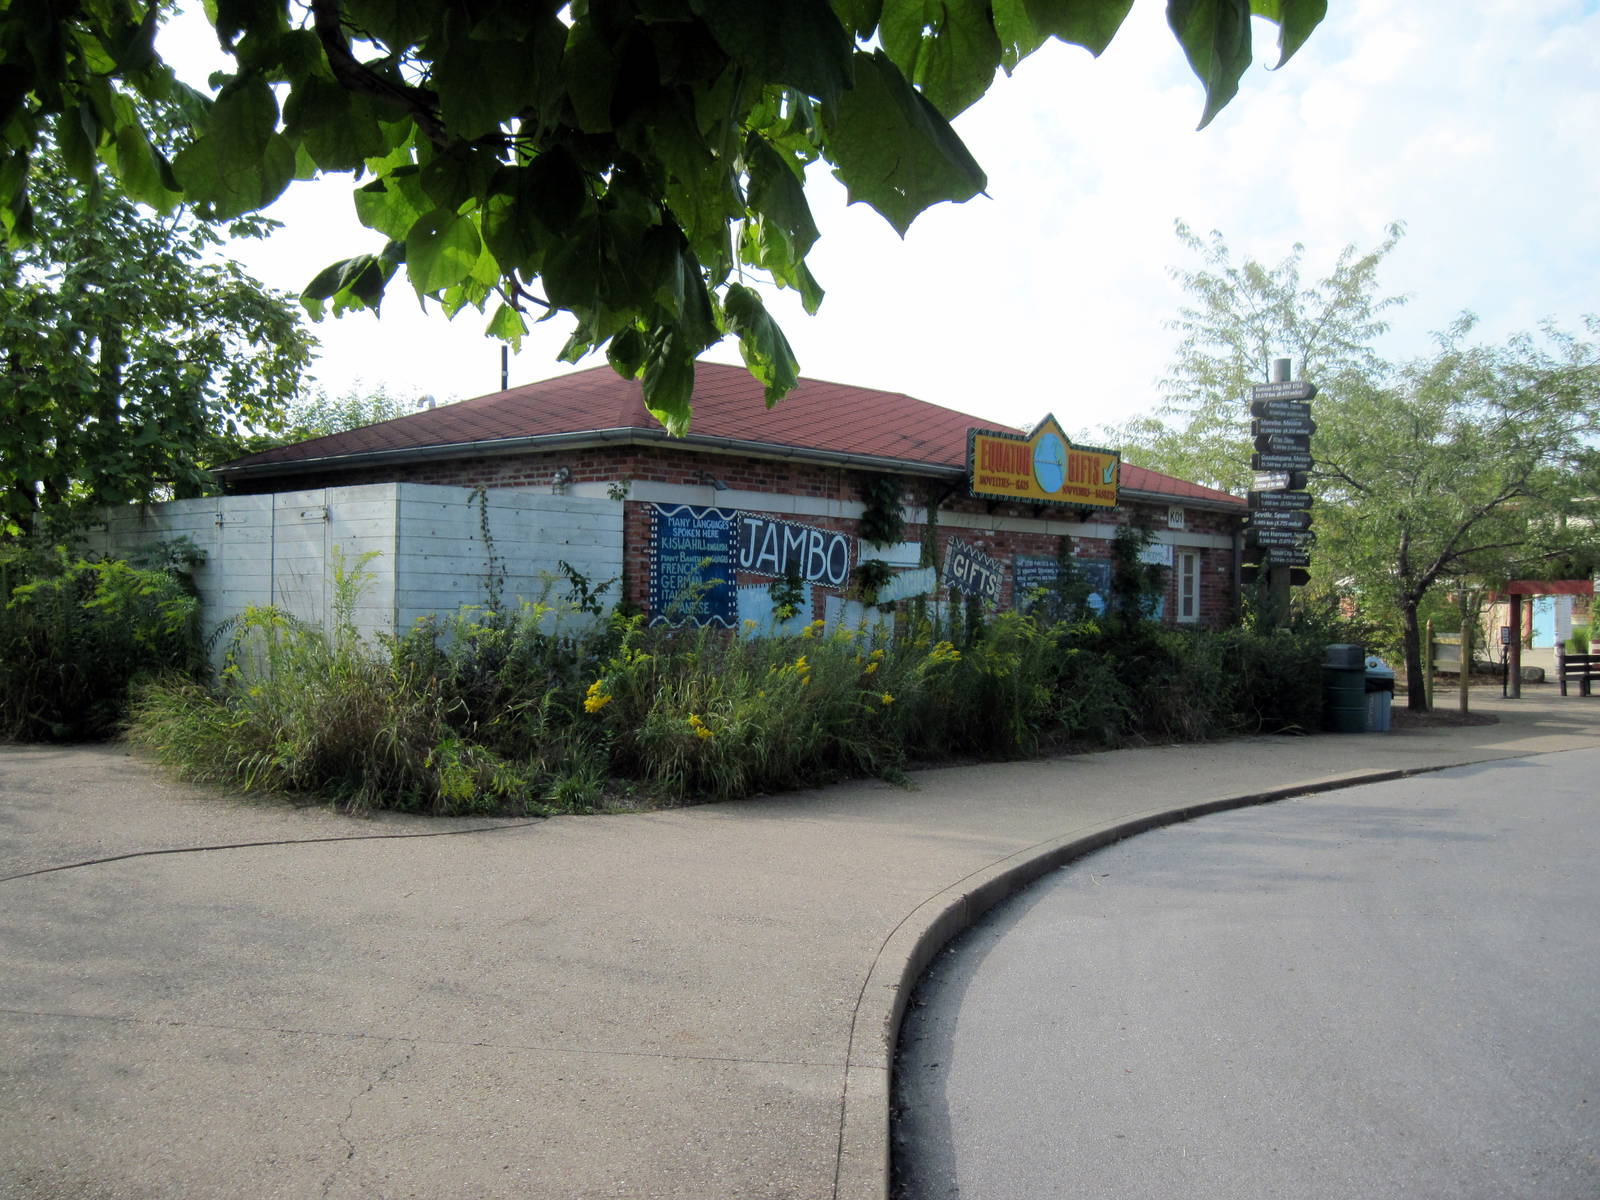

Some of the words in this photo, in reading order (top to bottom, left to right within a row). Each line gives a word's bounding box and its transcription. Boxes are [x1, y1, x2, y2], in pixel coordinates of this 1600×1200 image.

[981, 439, 1032, 476] EQUATOR
[1068, 454, 1101, 486] GIFTS
[668, 517, 690, 527] MANY
[692, 518, 730, 530] LANGUAGES
[672, 527, 701, 538] SPOKEN
[702, 529, 719, 538] HERE
[740, 518, 849, 585] JAMBO
[661, 562, 698, 575] FRENCH
[953, 554, 998, 595] GIFTS
[661, 575, 703, 590] GERMAN
